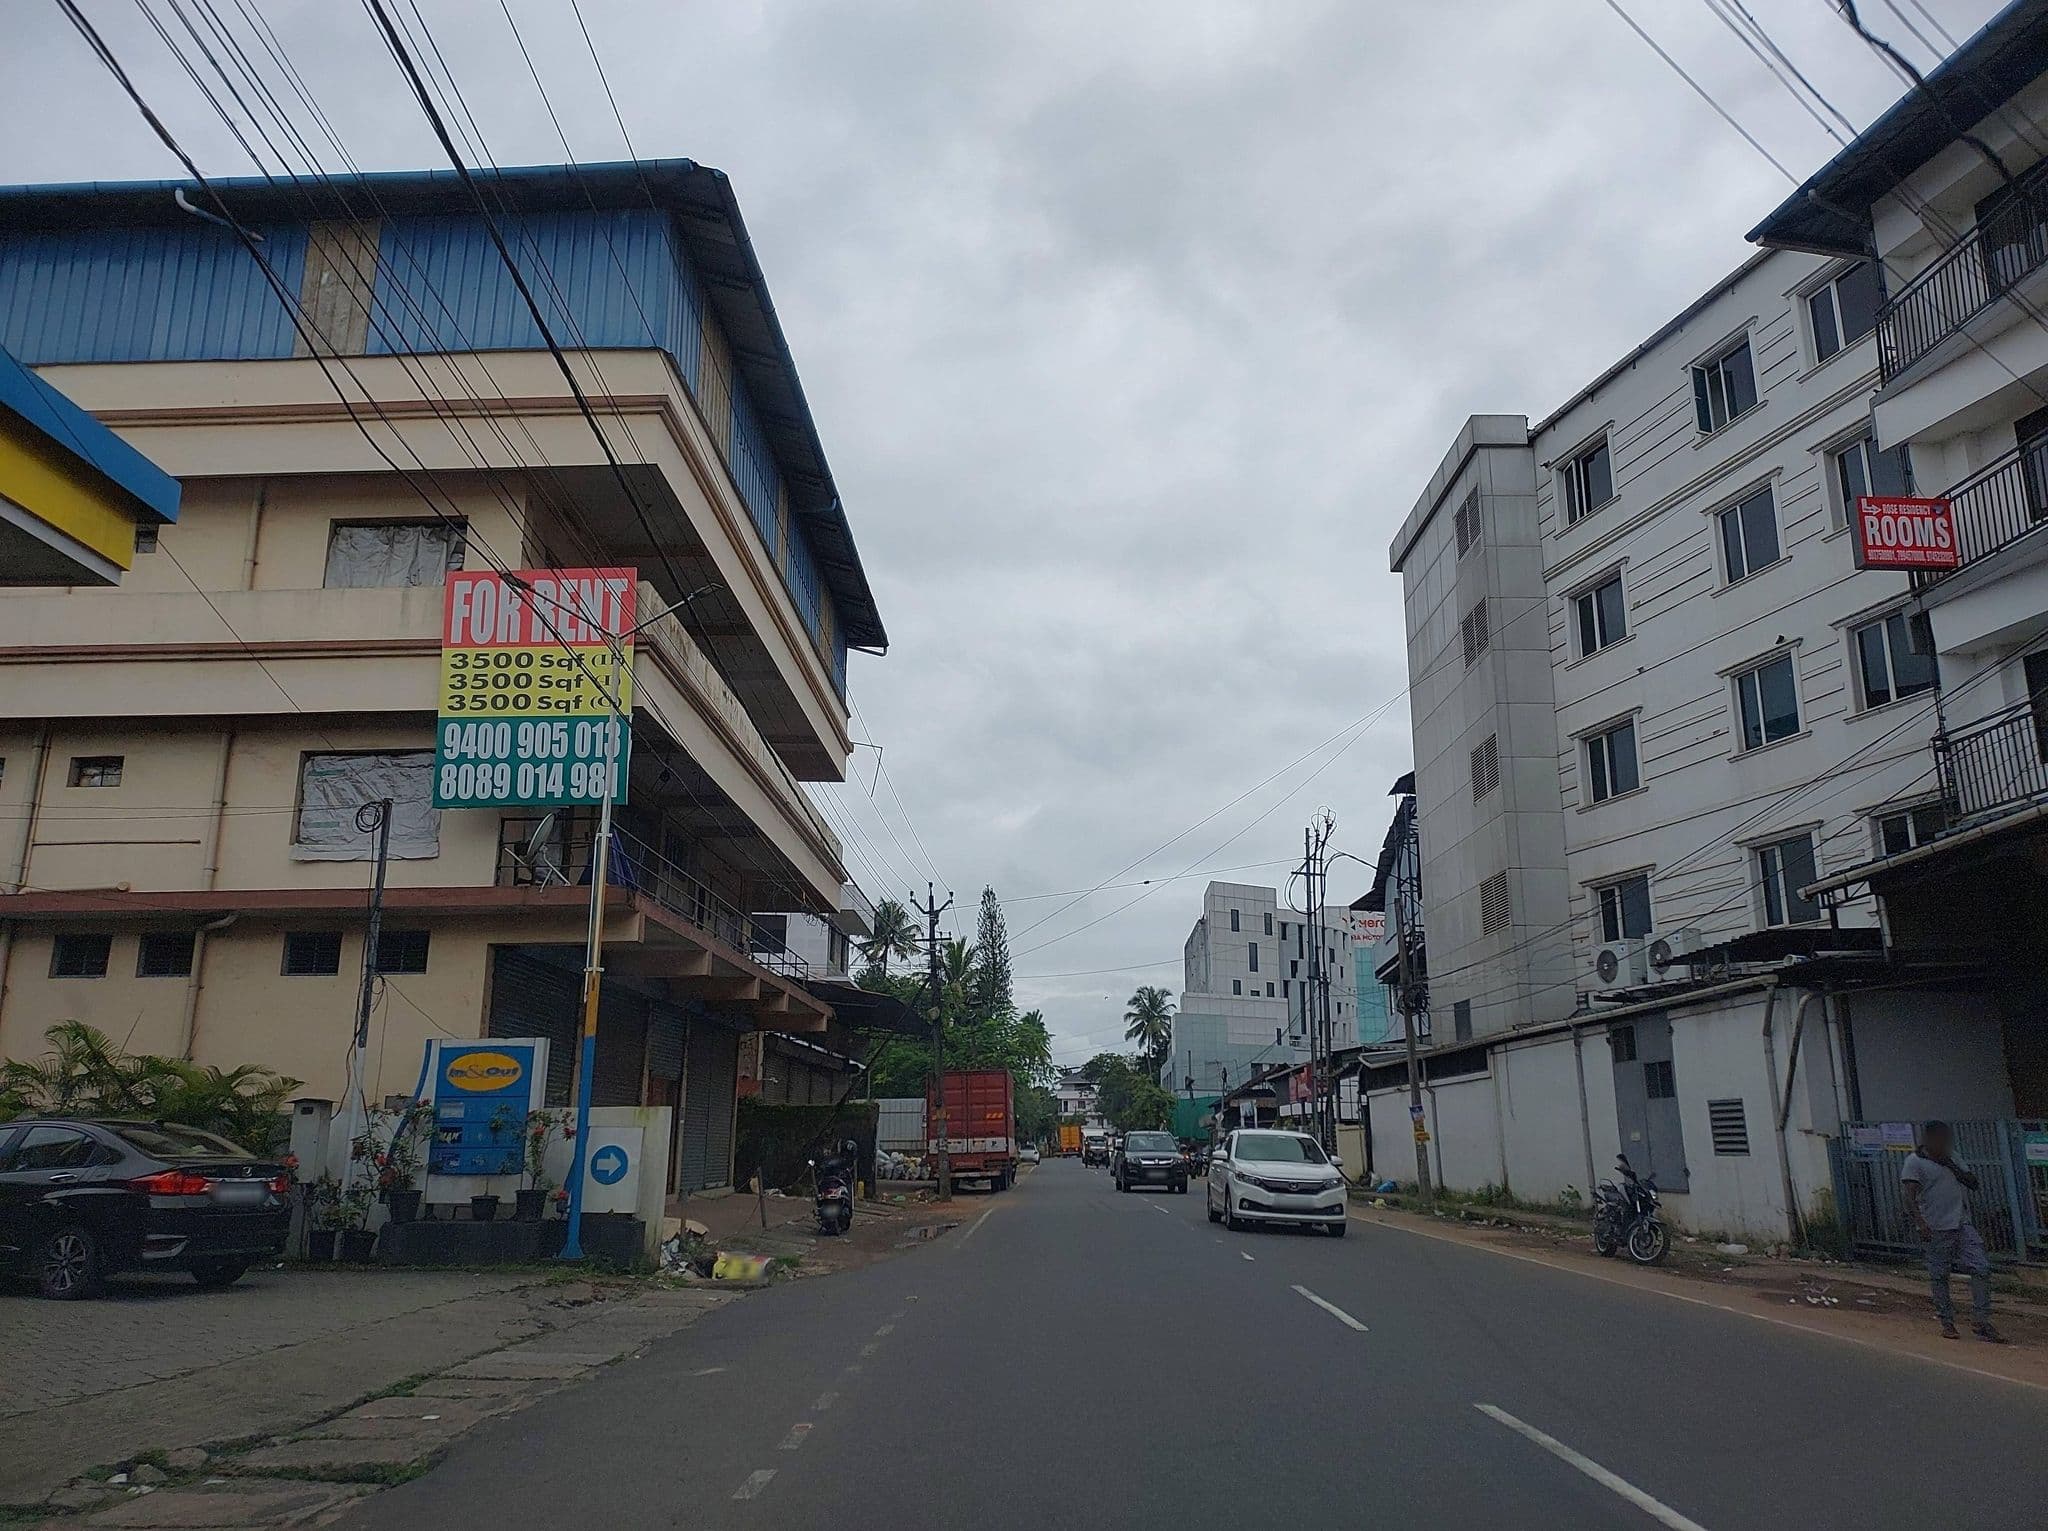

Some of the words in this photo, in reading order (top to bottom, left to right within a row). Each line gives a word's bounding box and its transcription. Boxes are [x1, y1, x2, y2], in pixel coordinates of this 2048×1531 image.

[1864, 515, 1951, 548] ROOMS
[450, 579, 522, 645] FOR
[530, 578, 629, 644] RENT
[450, 652, 534, 669] 3500
[539, 653, 585, 671] Sqf
[448, 673, 533, 690] 3500
[538, 673, 584, 692] Sqf
[447, 693, 532, 711] 3500
[537, 694, 583, 713] Sqf
[444, 722, 511, 759] 9400
[517, 722, 569, 759] 905
[440, 762, 511, 800] 8089
[516, 762, 564, 799] 014
